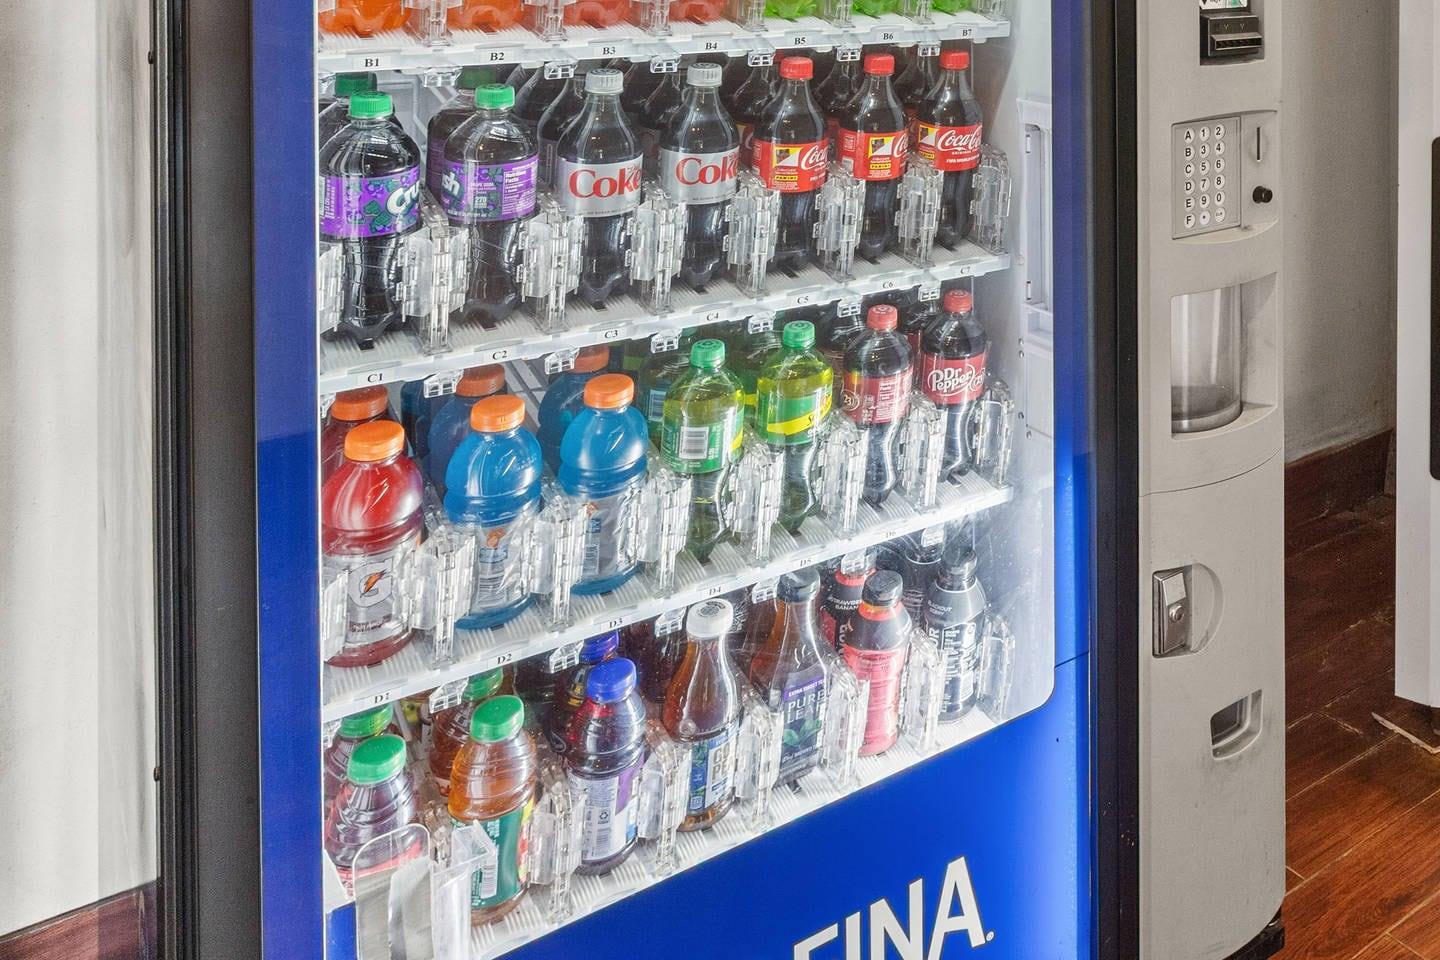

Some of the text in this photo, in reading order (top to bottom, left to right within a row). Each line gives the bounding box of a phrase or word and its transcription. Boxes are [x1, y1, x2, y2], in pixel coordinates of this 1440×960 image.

[364, 58, 380, 67] B1
[490, 52, 504, 61] B2
[602, 46, 616, 55] B3
[705, 42, 718, 51] B4
[569, 168, 641, 199] Coke
[367, 374, 383, 382] C1
[492, 351, 507, 360] C2
[604, 330, 618, 339] C3
[706, 313, 719, 321] C4
[932, 372, 972, 393] Pepper
[945, 368, 960, 381] Dr
[374, 693, 390, 703] D1
[496, 654, 512, 664] D2
[609, 618, 622, 628] D3
[788, 689, 825, 712] PURE
[787, 704, 822, 724] LEAF
